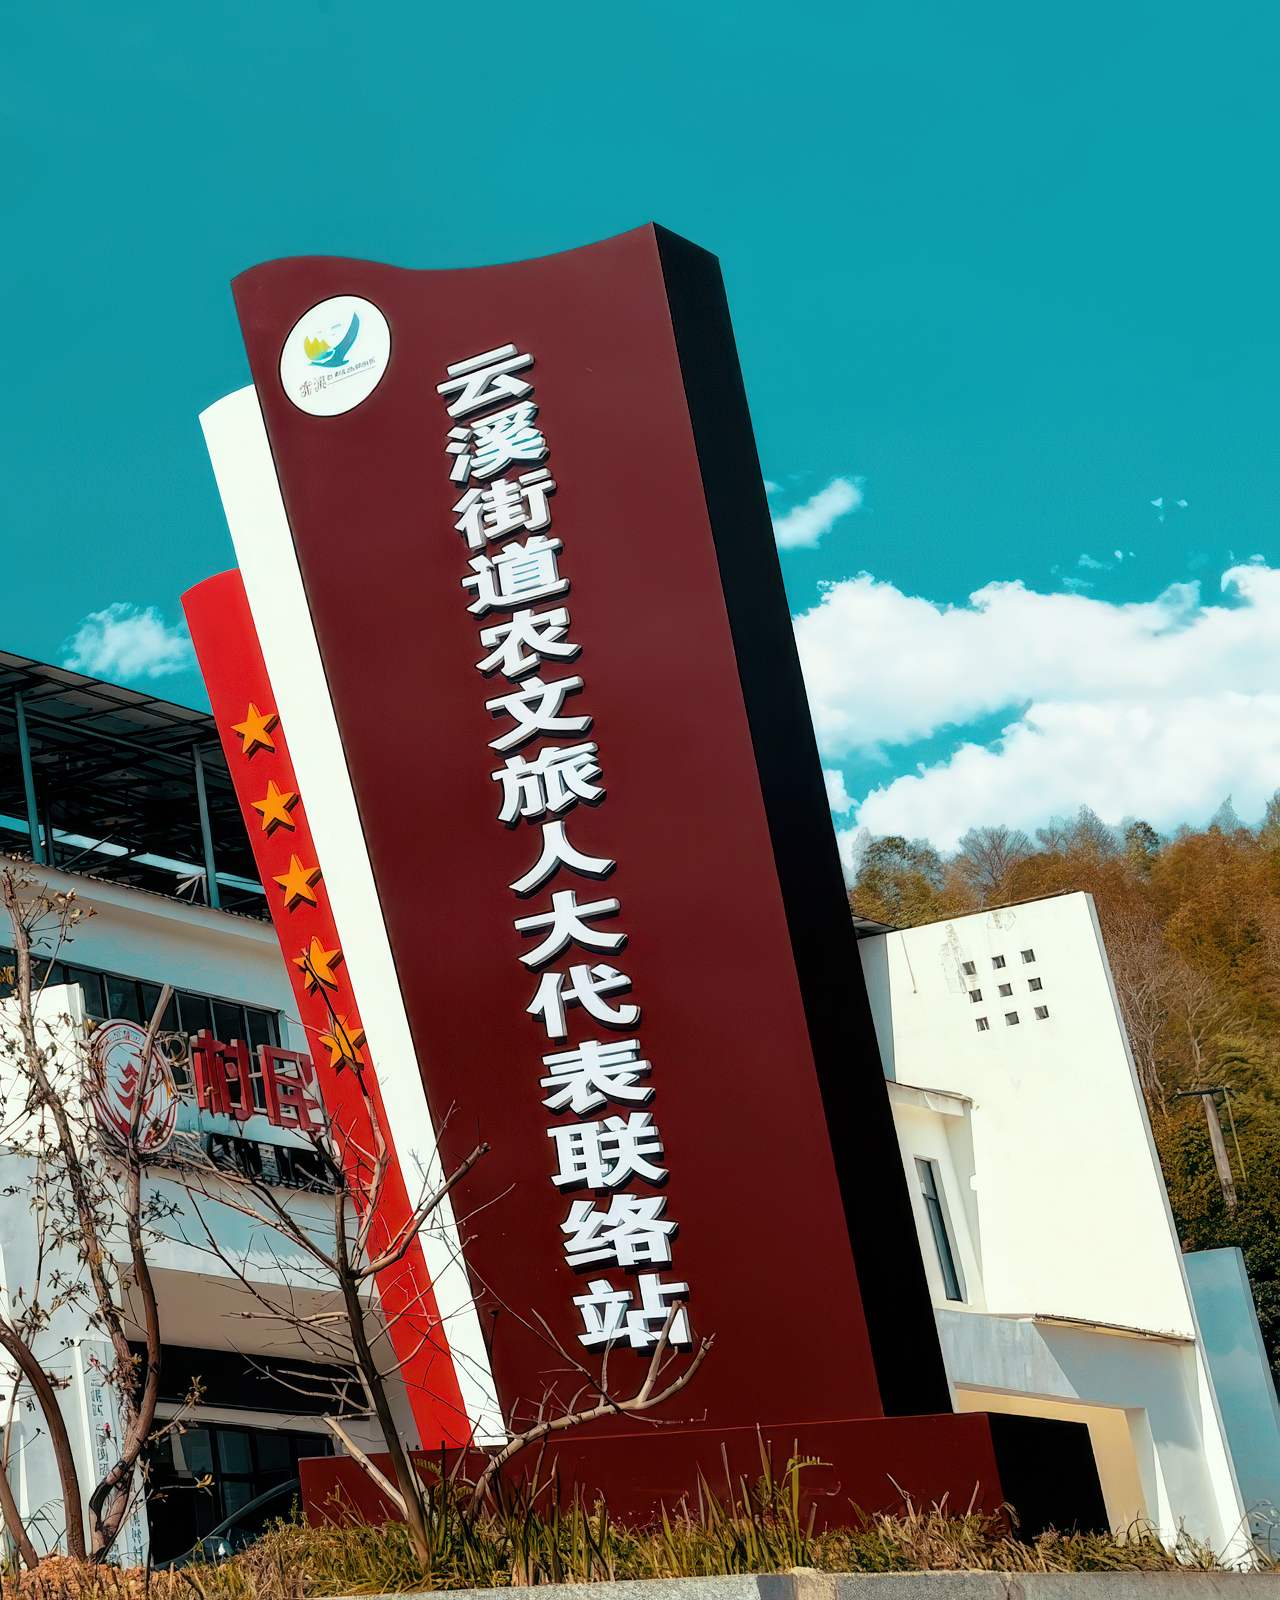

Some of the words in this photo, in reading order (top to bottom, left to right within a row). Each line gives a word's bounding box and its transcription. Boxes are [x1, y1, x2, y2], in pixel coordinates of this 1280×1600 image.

[437, 343, 694, 1352] 云溪街道农文旅人大代表联络站
